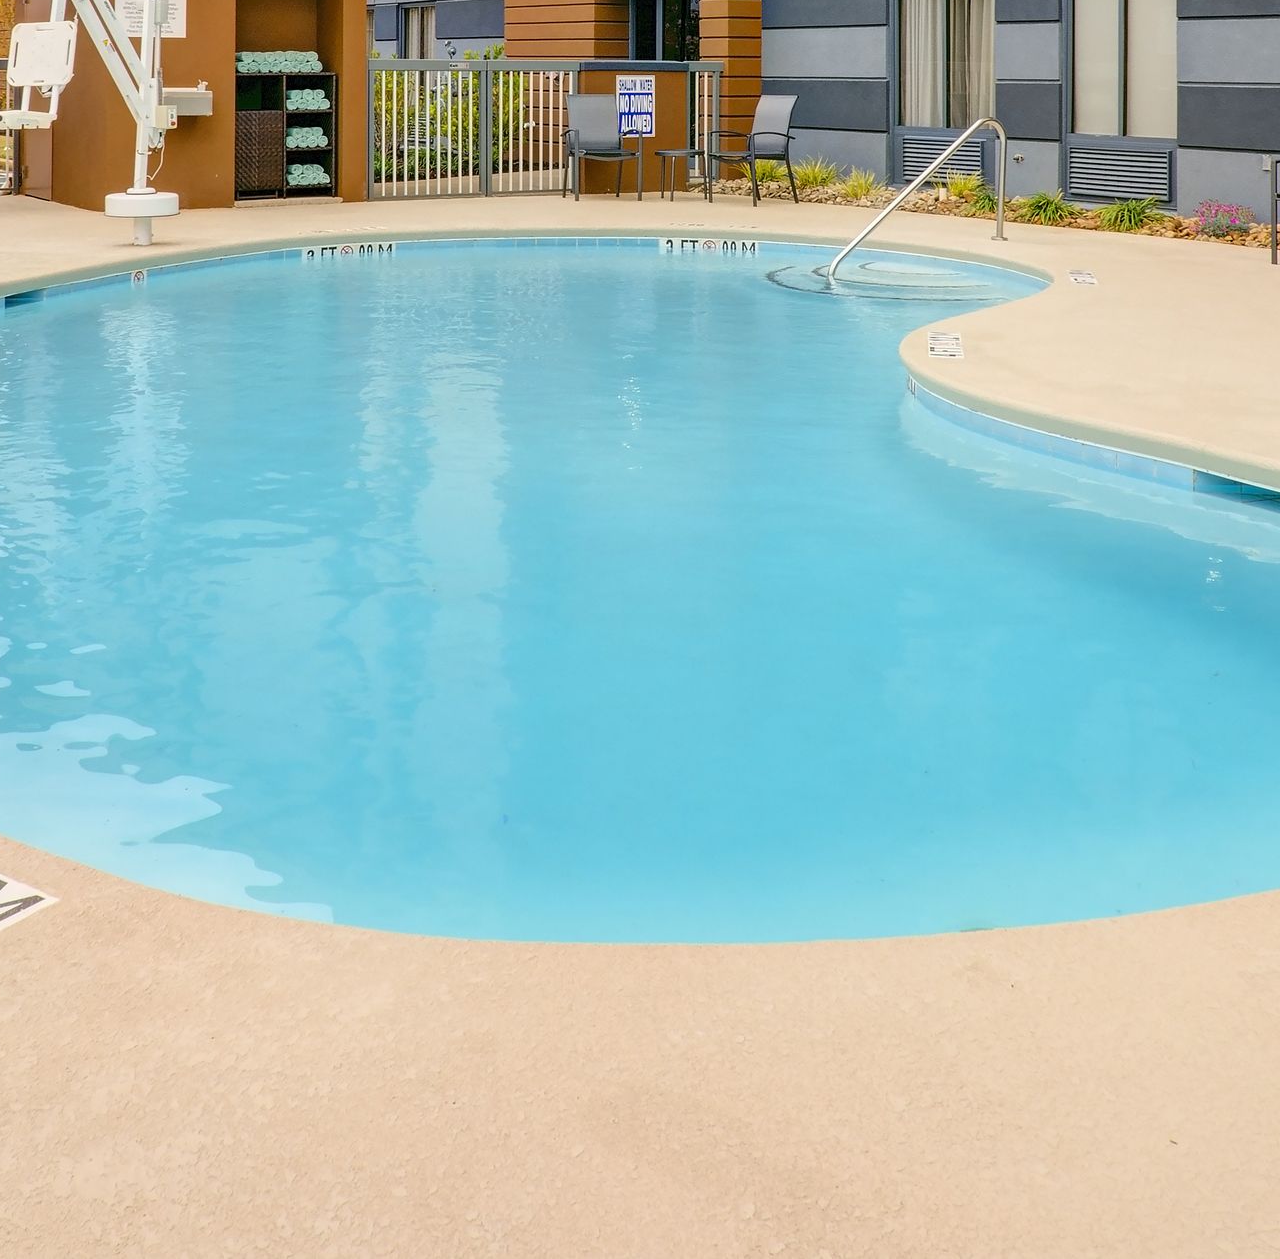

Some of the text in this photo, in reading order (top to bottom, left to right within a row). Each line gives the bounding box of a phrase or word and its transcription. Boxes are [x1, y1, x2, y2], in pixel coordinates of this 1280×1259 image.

[619, 94, 653, 113] NO DIVING
[620, 114, 652, 133] ALLOWED
